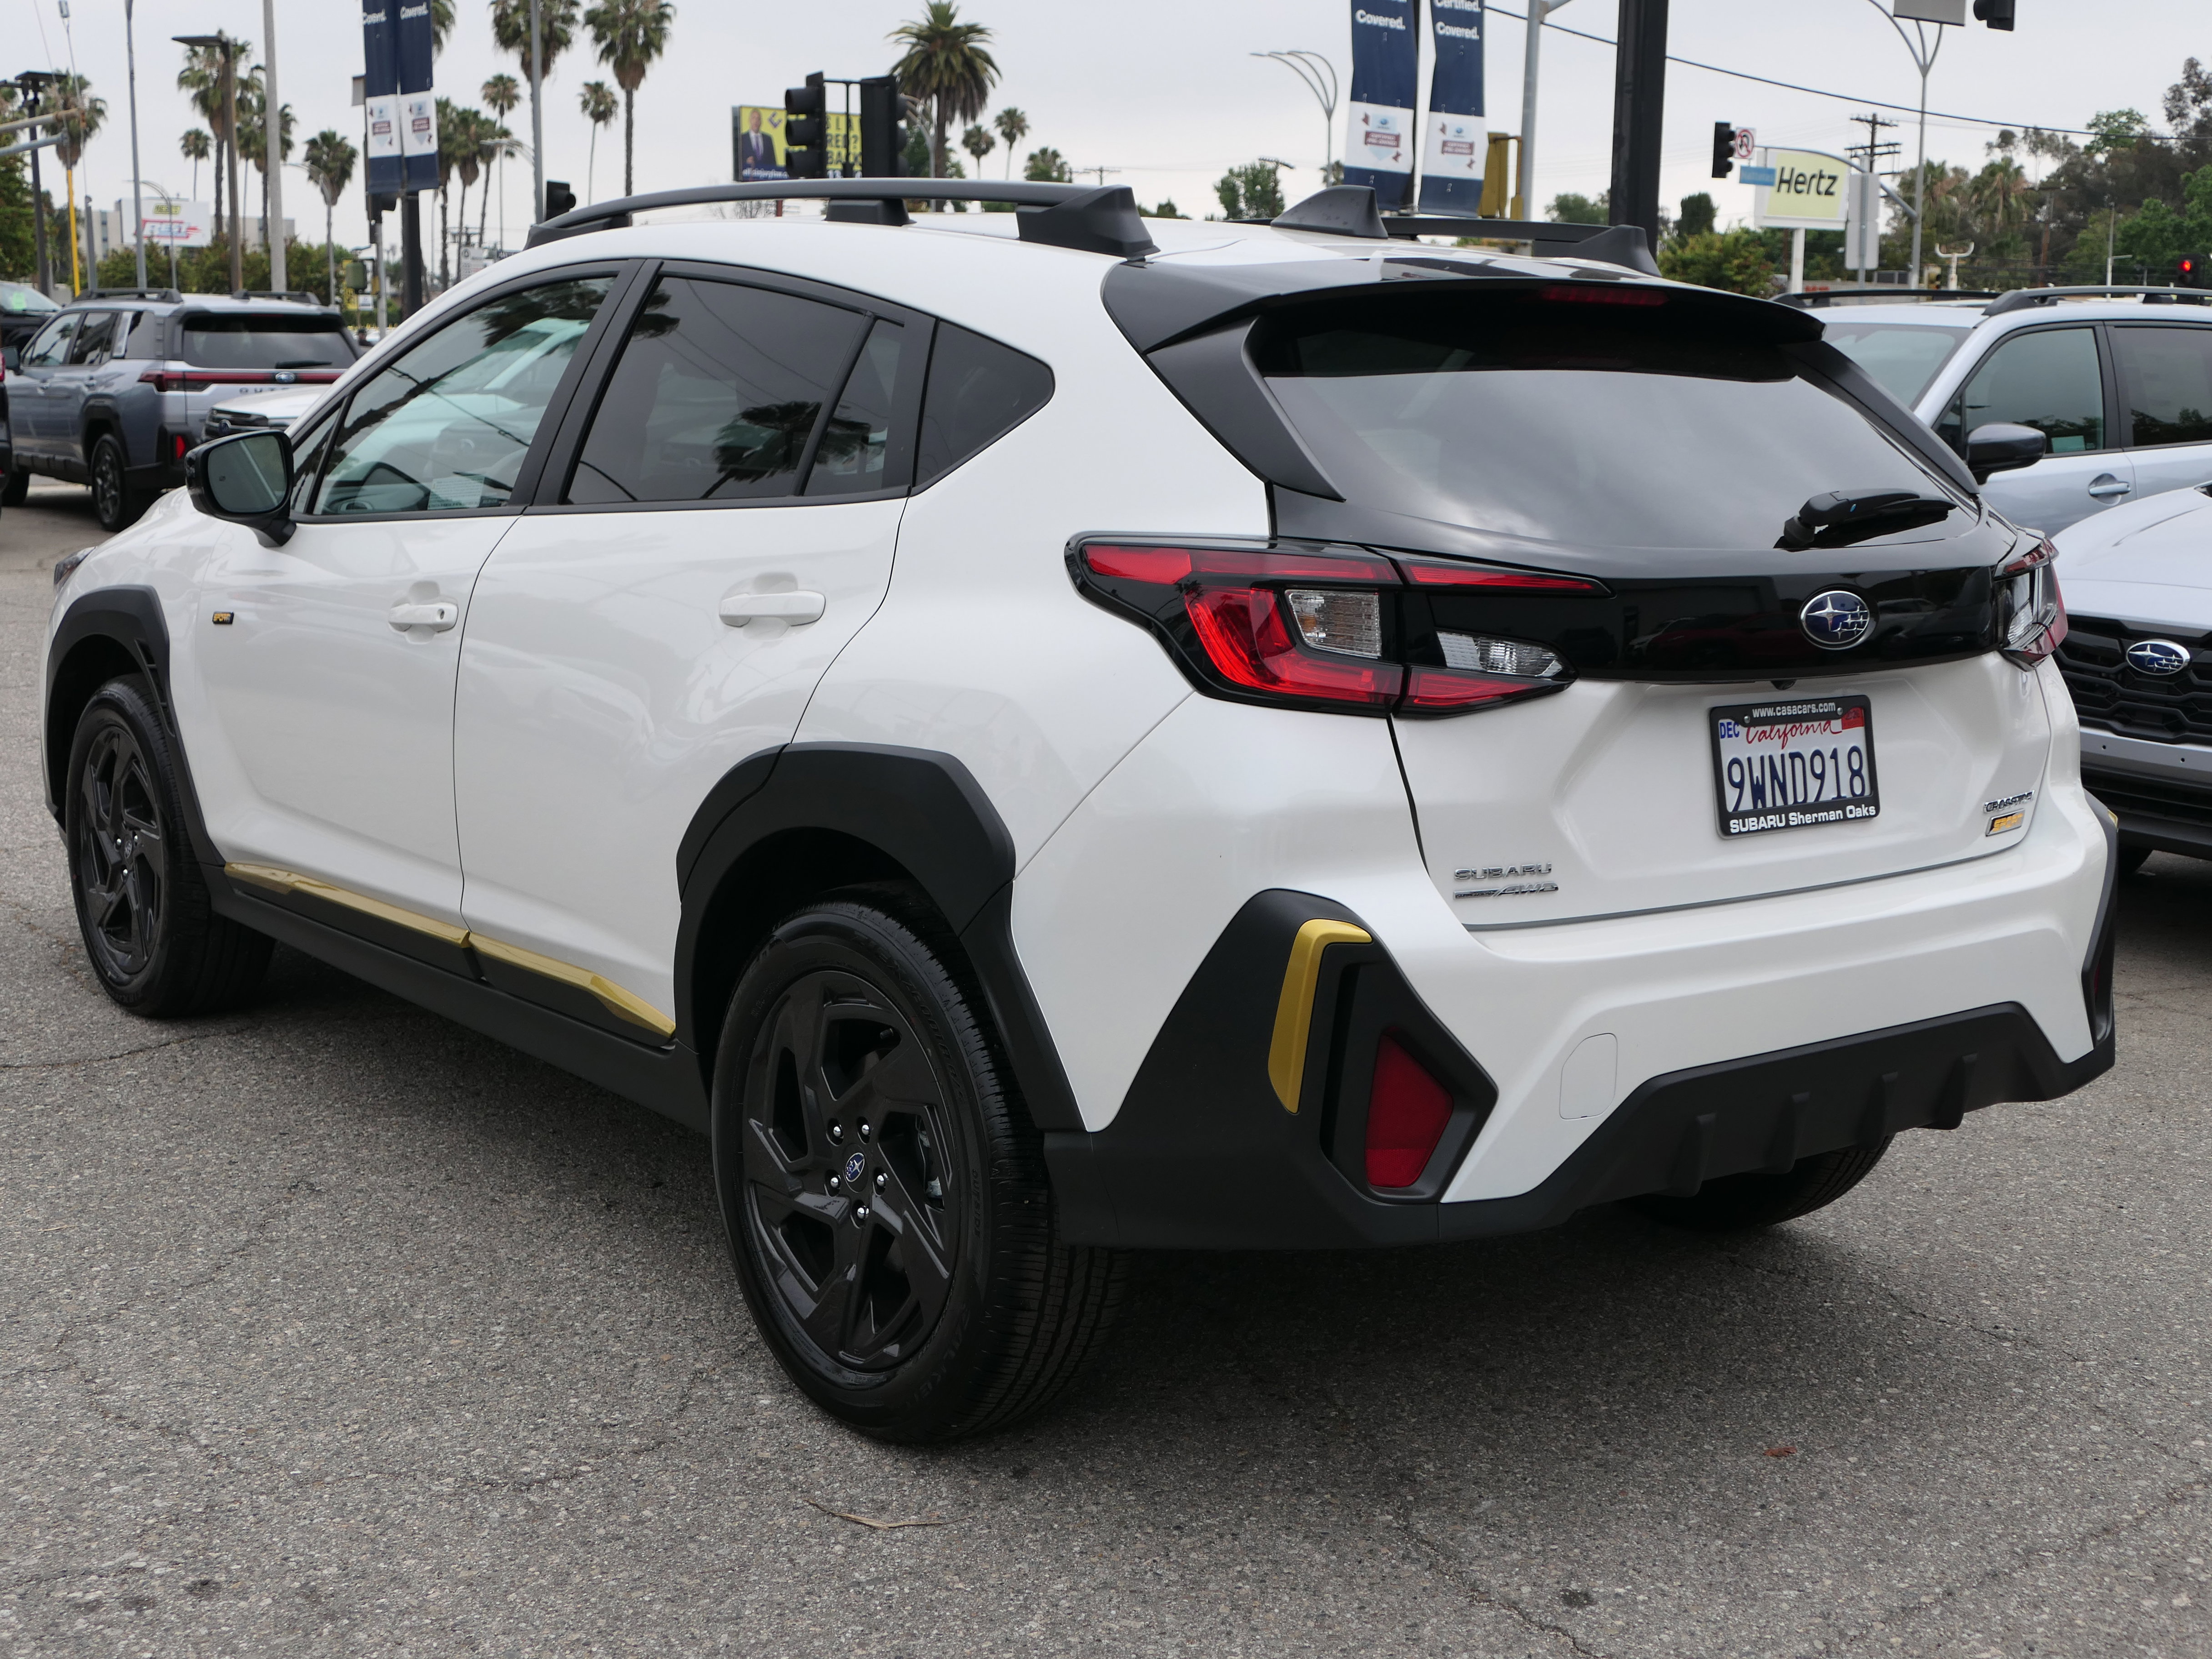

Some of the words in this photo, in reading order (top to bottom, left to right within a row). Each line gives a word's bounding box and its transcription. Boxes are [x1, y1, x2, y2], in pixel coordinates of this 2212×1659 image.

[1355, 9, 1406, 31] Covered.
[1435, 21, 1479, 40] Covered.
[1777, 166, 1839, 196] Hertz
[1752, 702, 1836, 718] www.casacars.com
[1719, 721, 1740, 739] DEC
[1746, 720, 1843, 750] California
[1727, 745, 1865, 812] 9WND918
[1729, 814, 1786, 834] SUBARU
[1789, 809, 1843, 826] Sherman
[1845, 804, 1876, 819] Oaks
[1454, 862, 1552, 880] SUBARU
[1492, 881, 1559, 898] AWD
